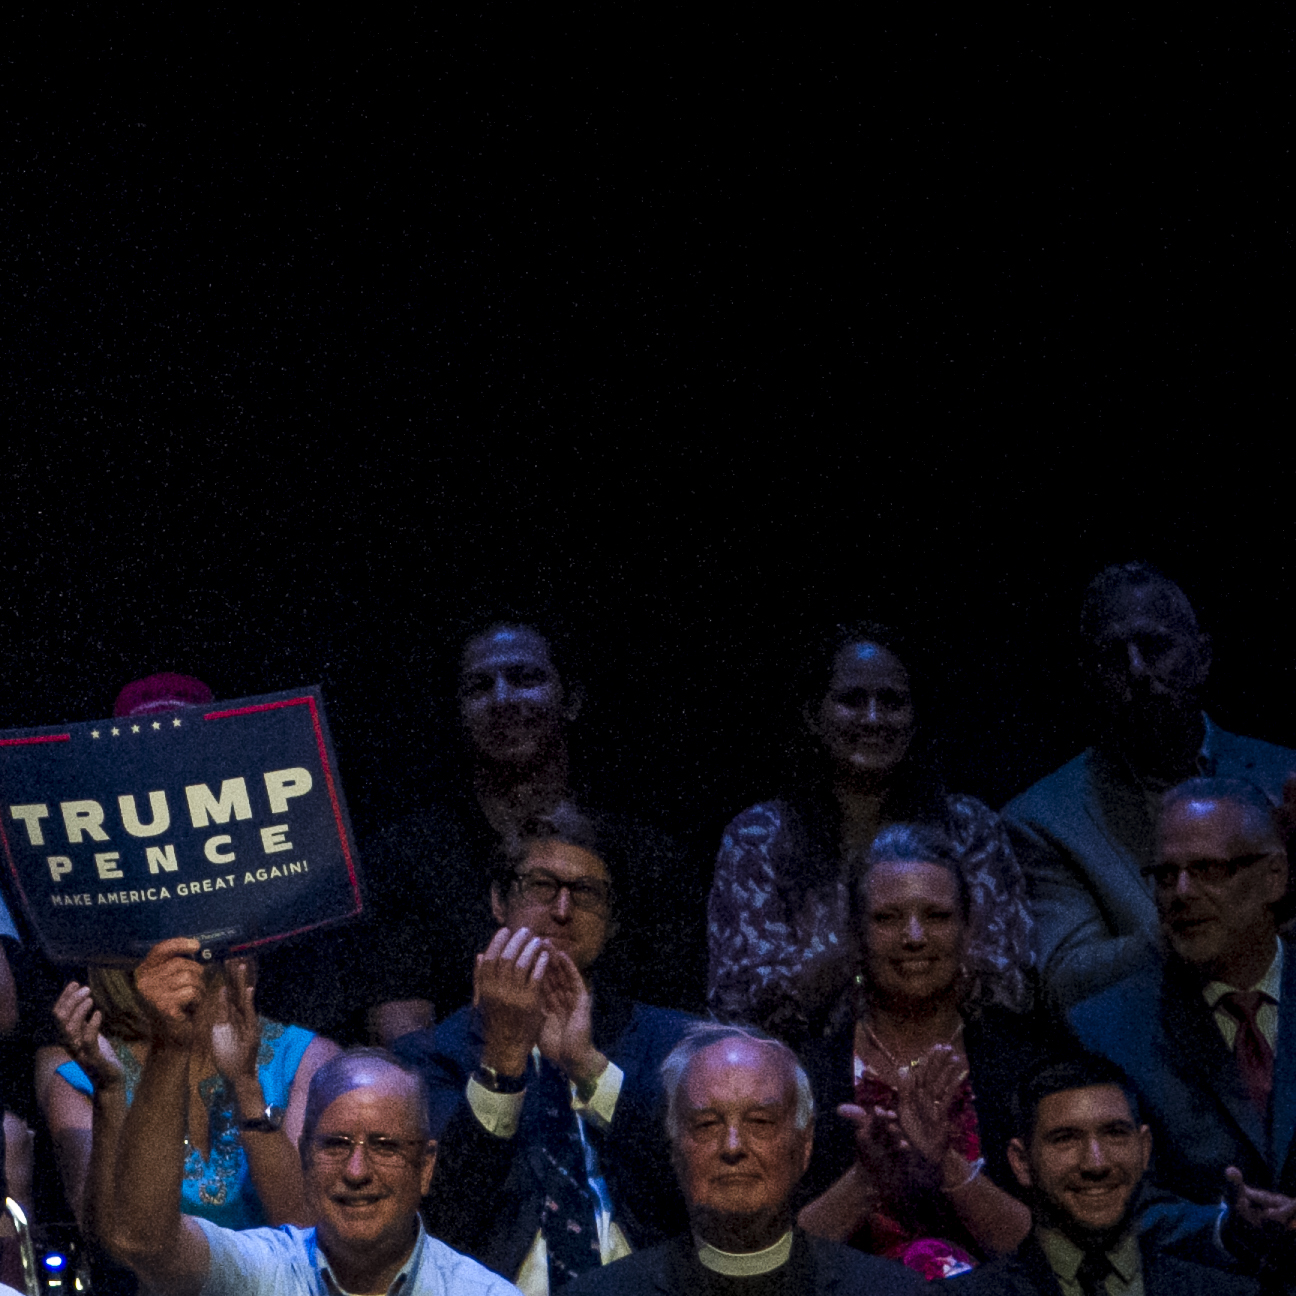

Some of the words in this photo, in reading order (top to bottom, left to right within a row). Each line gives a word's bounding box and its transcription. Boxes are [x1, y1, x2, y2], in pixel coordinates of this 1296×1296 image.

[10, 766, 313, 847] TRUMP
[46, 823, 294, 882] PENCE
[51, 893, 93, 907] MAKE
[97, 886, 172, 905] AMERICA
[177, 874, 236, 896] GREAT
[244, 860, 310, 884] AGAIN!
